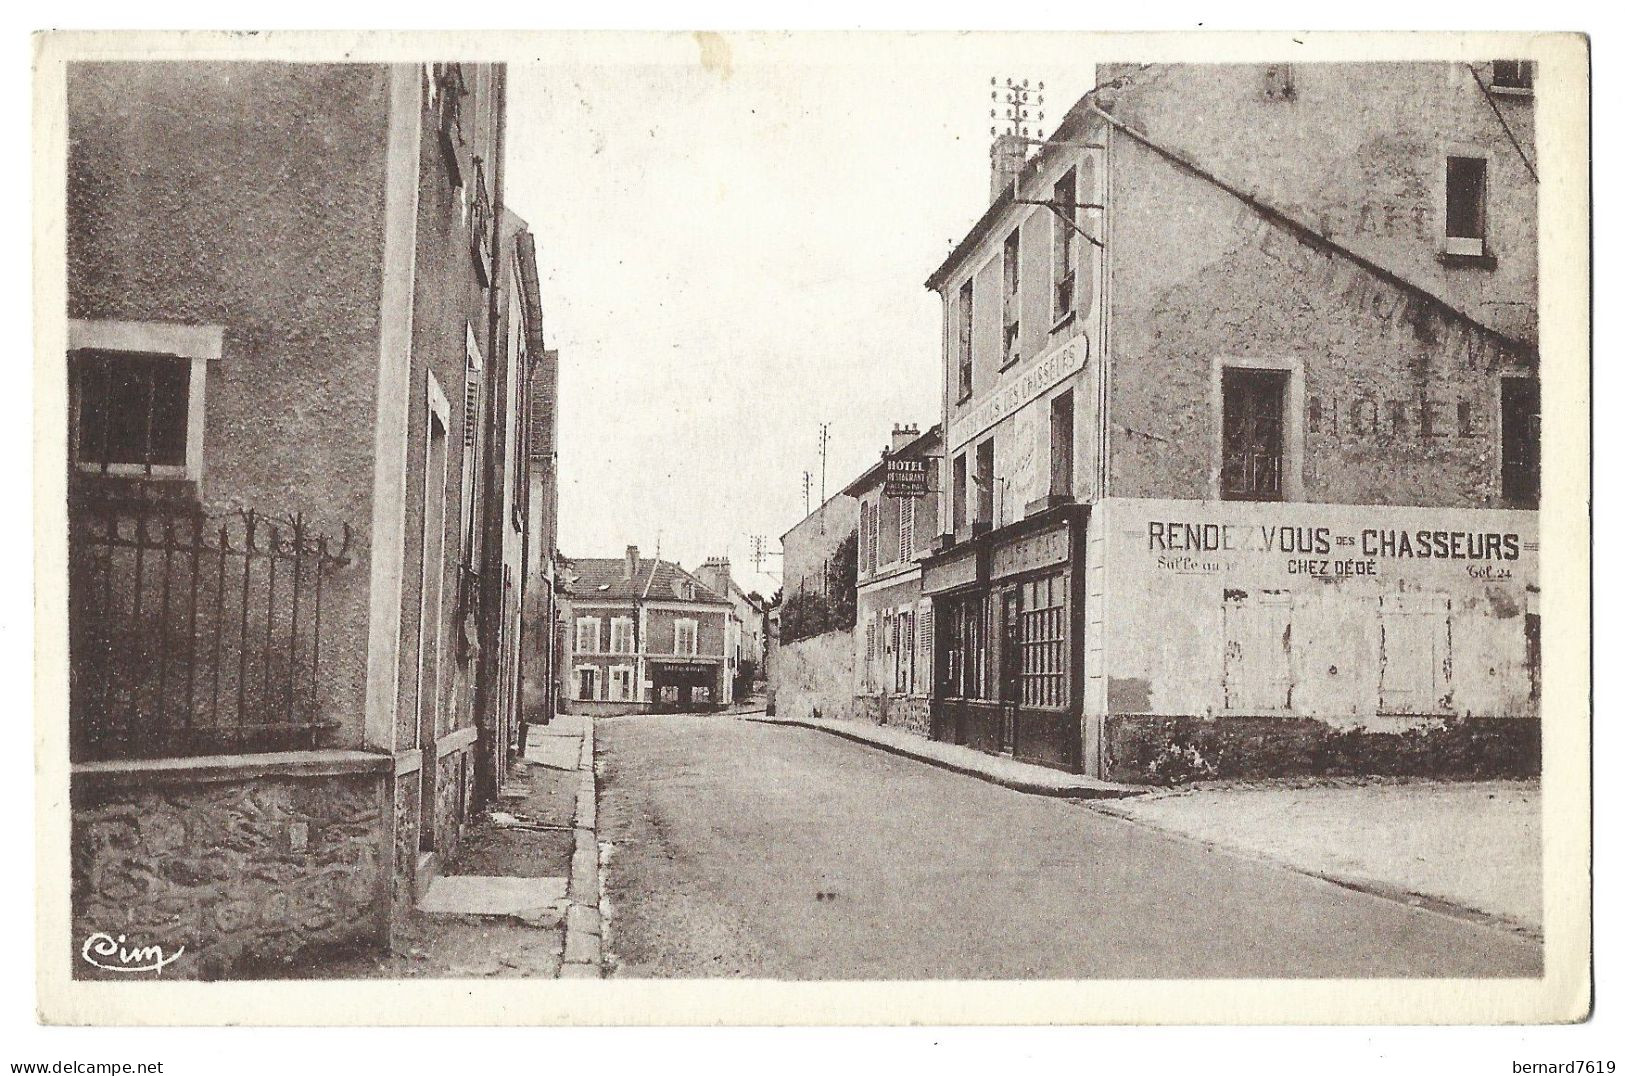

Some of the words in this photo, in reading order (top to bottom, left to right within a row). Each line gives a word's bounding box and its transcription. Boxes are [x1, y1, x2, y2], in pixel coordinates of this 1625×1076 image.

[887, 459, 925, 472] HÔTEL
[1336, 536, 1356, 546] DES
[1362, 529, 1520, 561] CHASSEURS
[1157, 556, 1198, 571] Salle
[1288, 559, 1329, 575] CHEZ
[1497, 568, 1512, 579] 24
